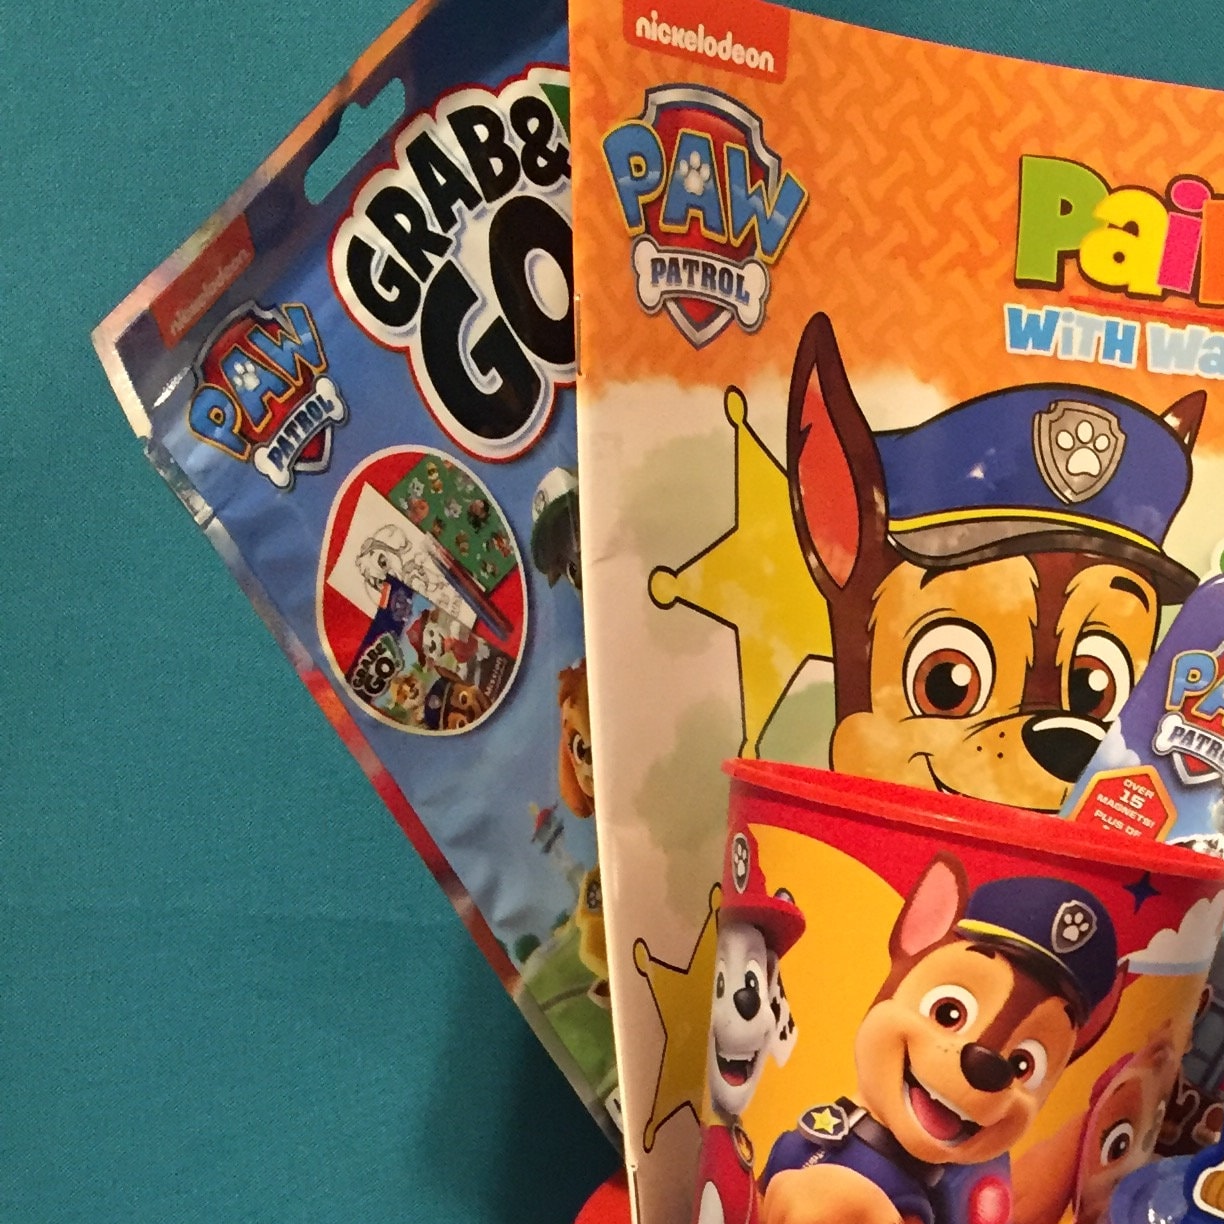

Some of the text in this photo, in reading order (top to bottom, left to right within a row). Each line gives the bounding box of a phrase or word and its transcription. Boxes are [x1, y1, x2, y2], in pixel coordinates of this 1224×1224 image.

[635, 9, 776, 73] nickelodeon
[601, 119, 809, 266] PAW
[650, 256, 752, 305] PATROL
[187, 302, 328, 463] PAW
[267, 394, 335, 472] PATROL
[1119, 788, 1146, 810] 15
[1122, 778, 1156, 800] OVER
[1093, 809, 1125, 830] PLUS
